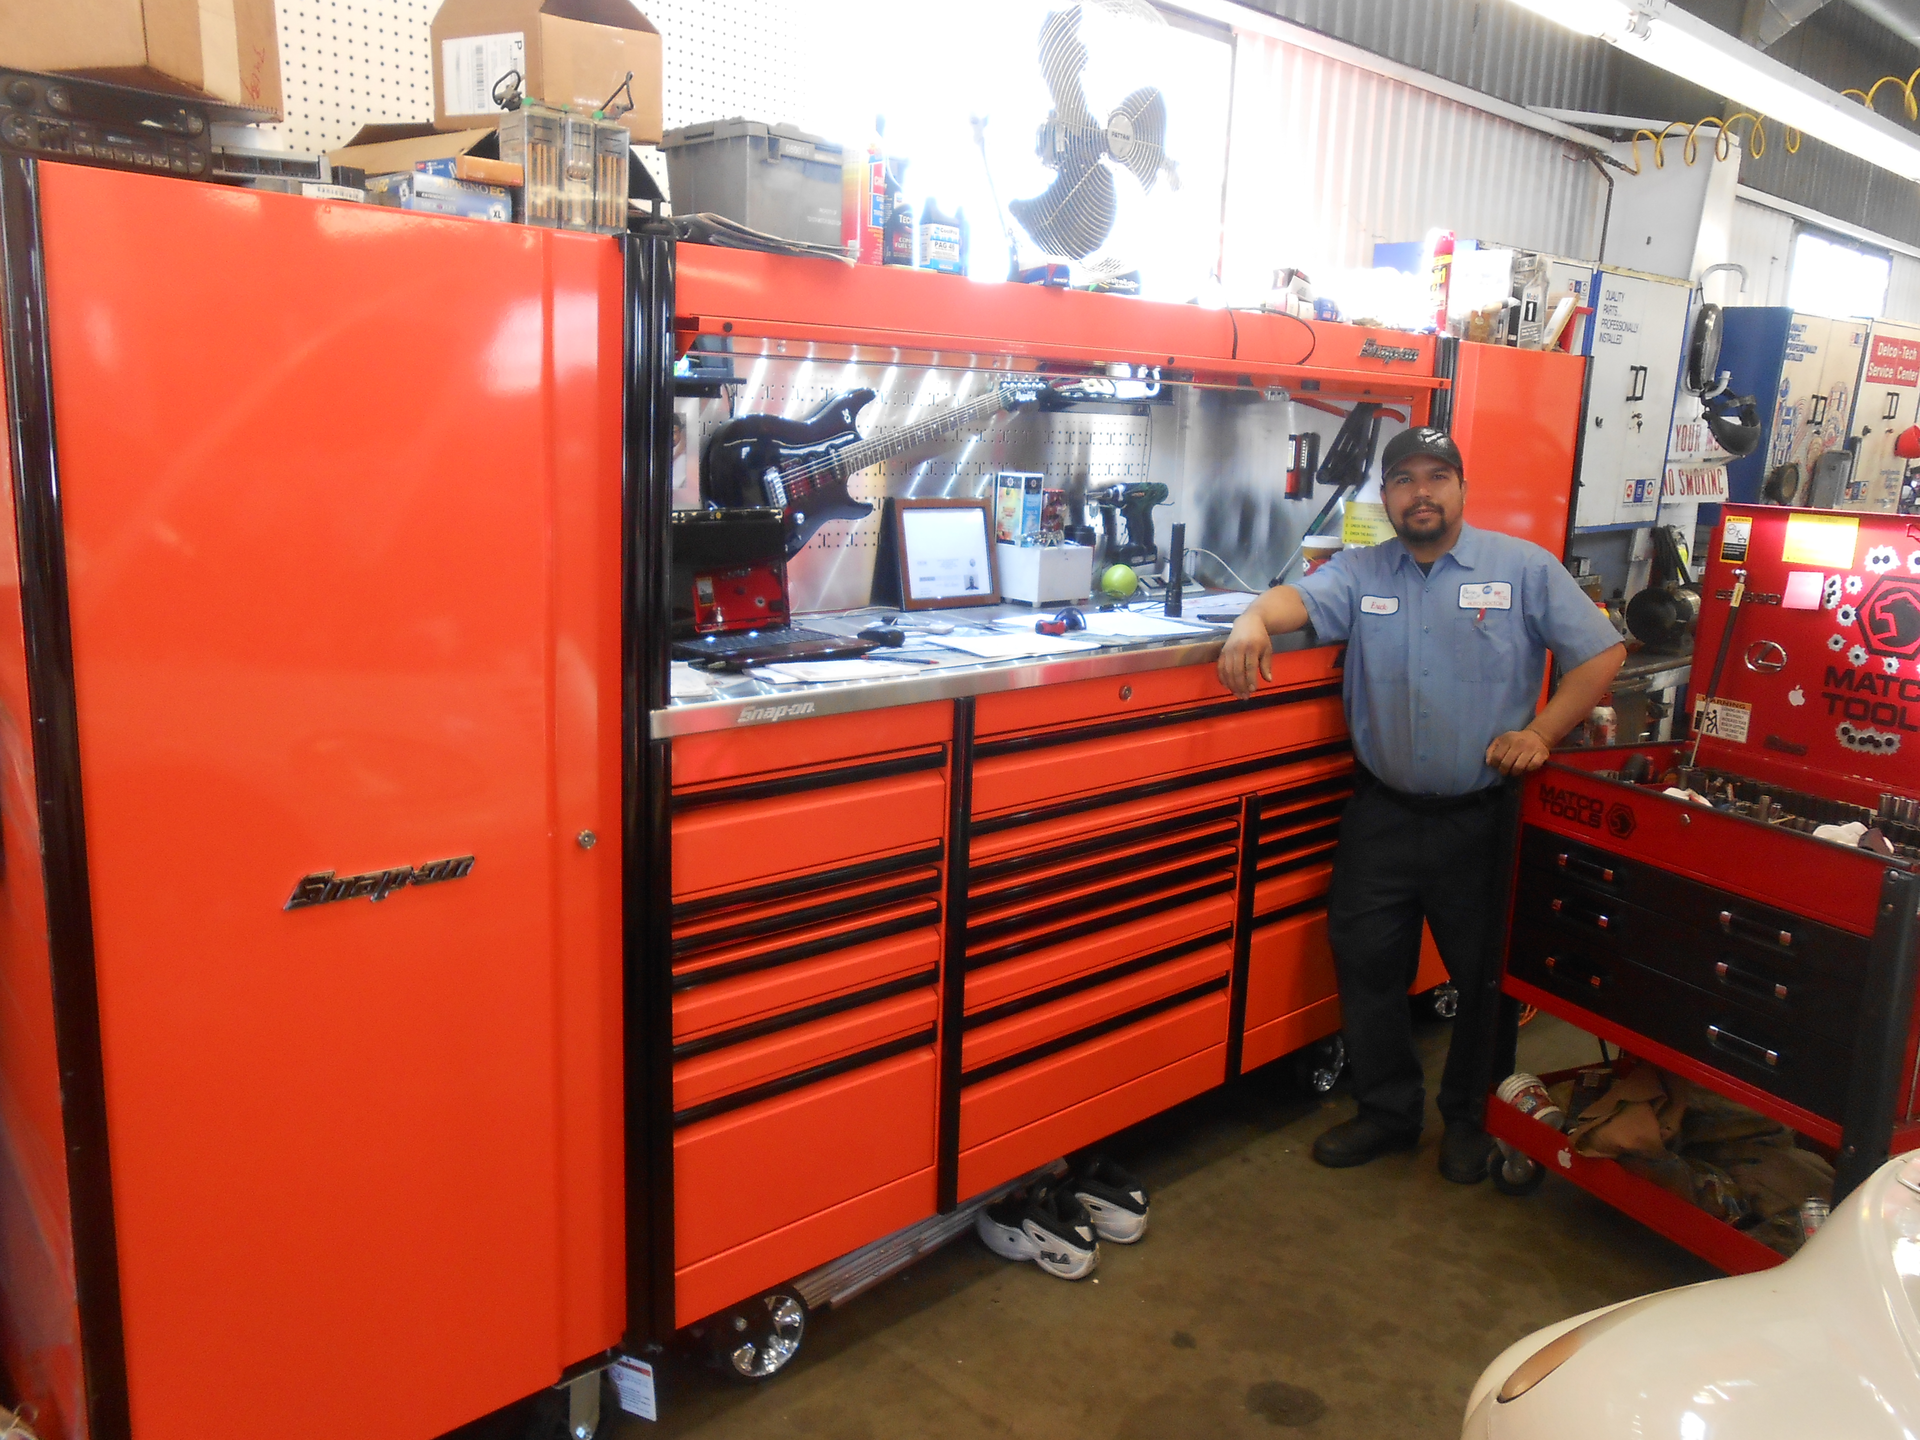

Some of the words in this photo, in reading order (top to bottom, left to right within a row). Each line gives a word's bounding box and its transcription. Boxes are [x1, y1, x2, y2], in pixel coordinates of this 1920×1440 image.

[489, 186, 506, 197] EC
[493, 210, 502, 219] XL
[1601, 318, 1639, 333] PROFESSIONALLY
[1599, 332, 1622, 344] INSTALLED
[1359, 337, 1420, 365] Snap-on
[1867, 361, 1894, 379] Service
[1896, 365, 1919, 382] Center
[1675, 423, 1702, 453] YOUR
[1678, 468, 1724, 496] SMOKING
[738, 702, 815, 723] Snap-on
[1539, 783, 1604, 815] MATCO
[1539, 797, 1602, 829] TOOLS
[283, 854, 475, 910] Snap-on
[1041, 1250, 1070, 1265] FILA
